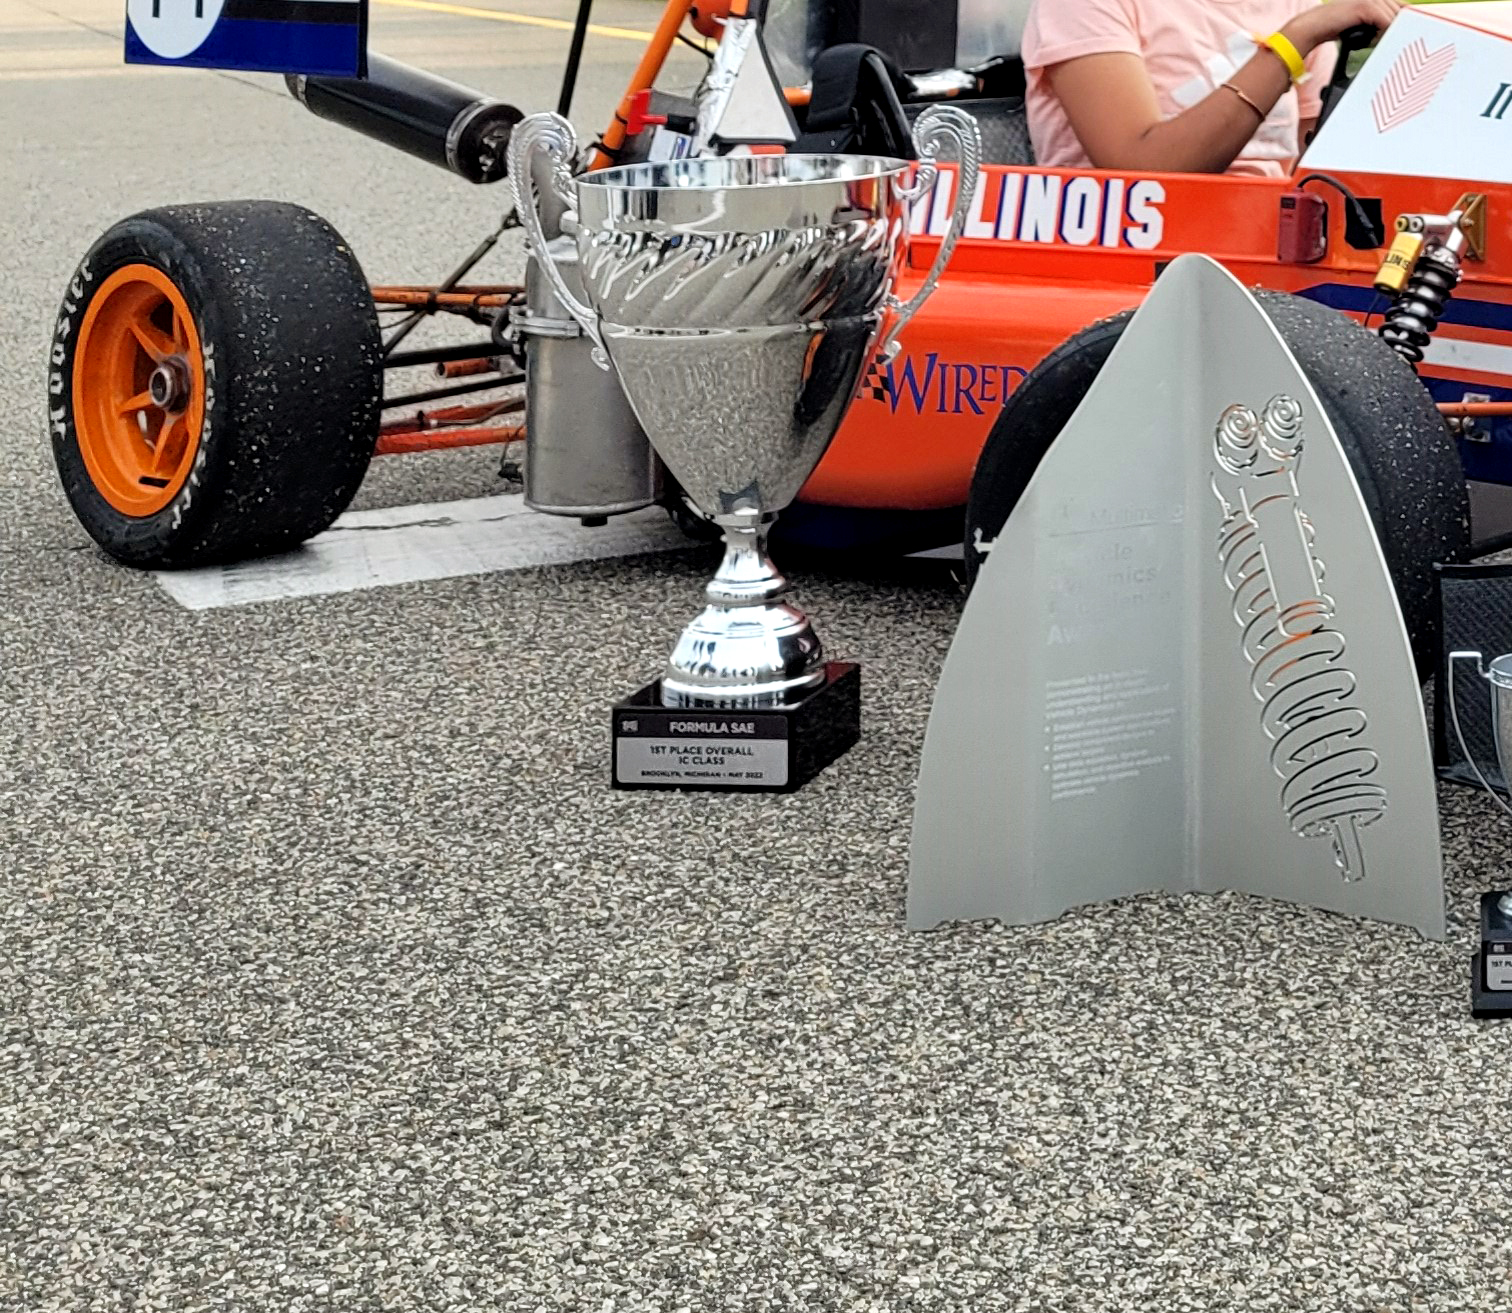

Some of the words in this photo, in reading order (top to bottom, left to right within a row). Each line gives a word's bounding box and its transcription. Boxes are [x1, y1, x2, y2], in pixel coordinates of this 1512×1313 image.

[670, 721, 729, 733] FORMULA
[731, 722, 755, 733] SAE
[651, 746, 666, 754] 1ST
[670, 746, 701, 755] PLACE
[706, 747, 753, 756] OVERALL
[693, 757, 725, 765] CLASS
